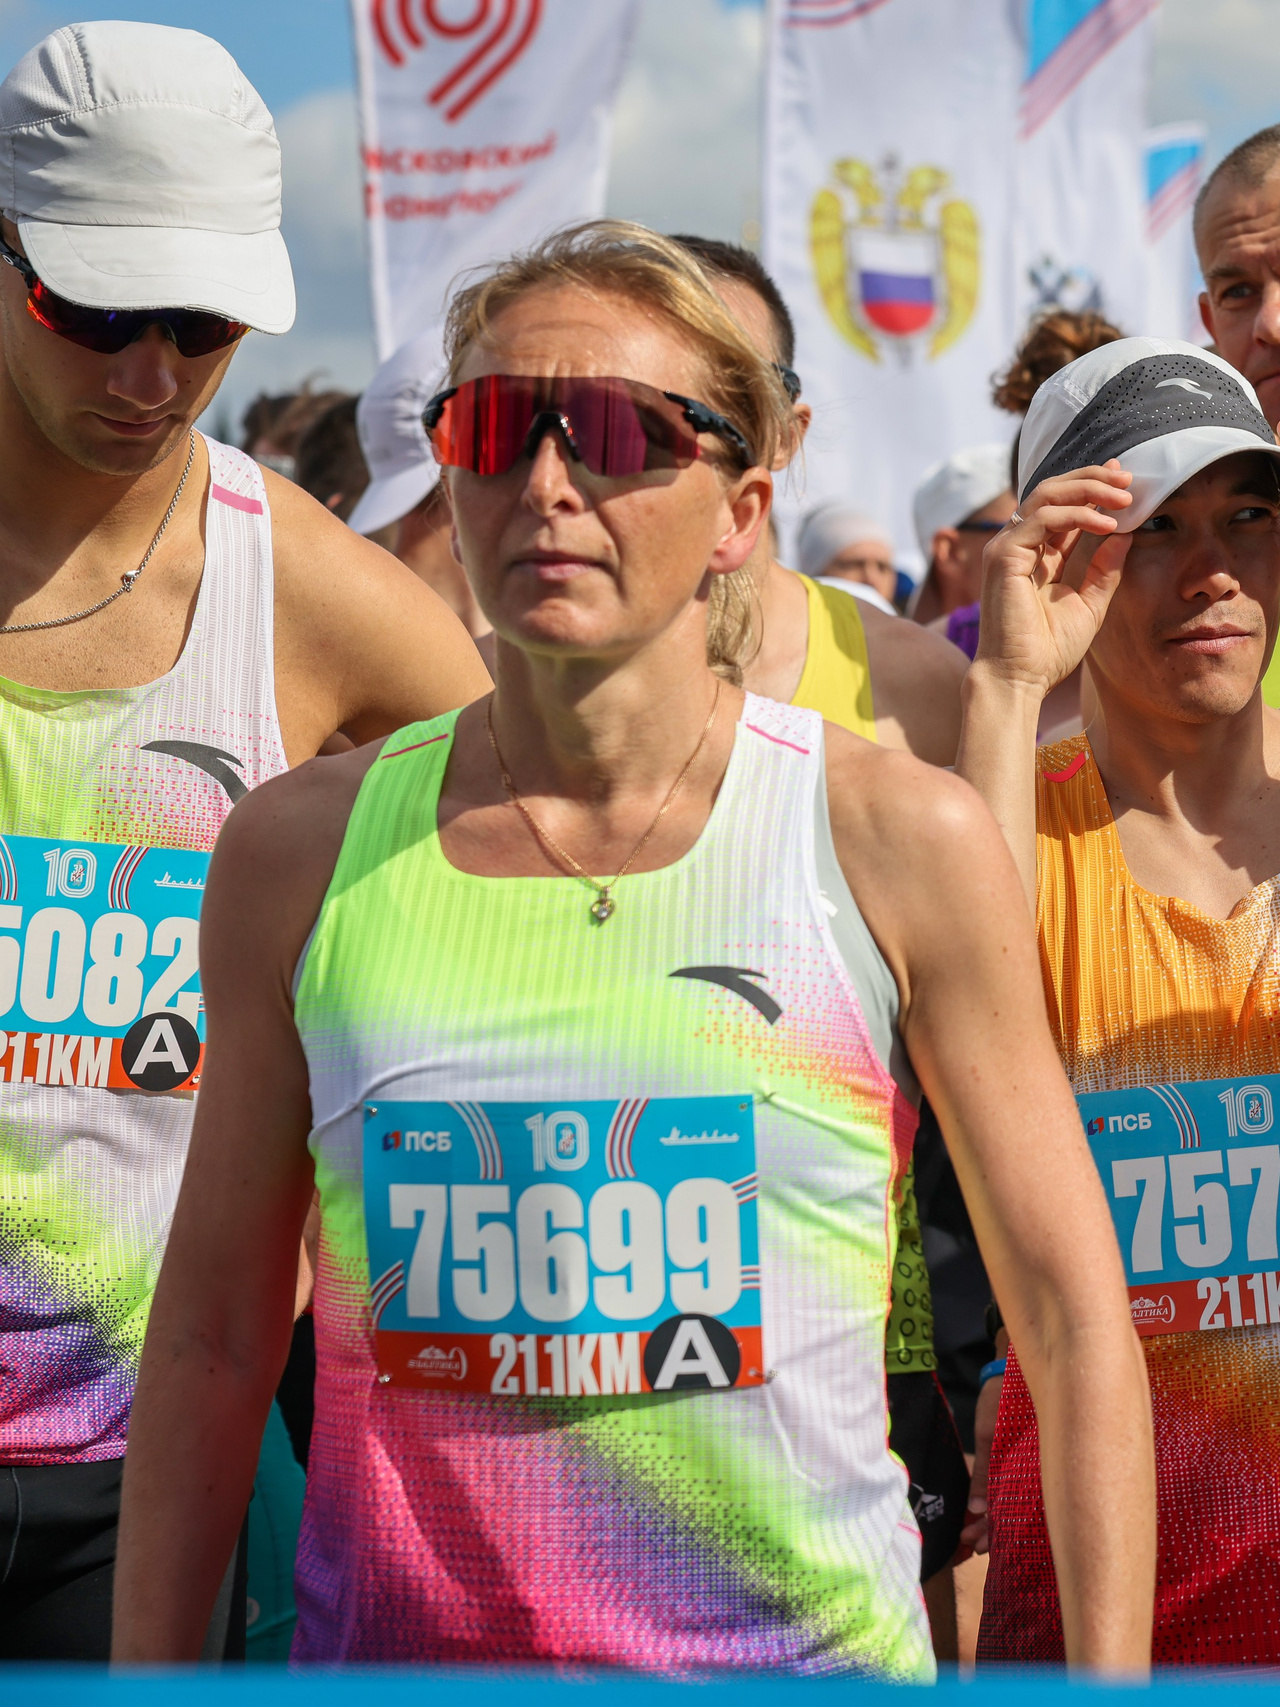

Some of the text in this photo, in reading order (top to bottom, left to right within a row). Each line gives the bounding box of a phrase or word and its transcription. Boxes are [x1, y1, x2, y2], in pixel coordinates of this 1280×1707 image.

[43, 848, 97, 899] 10
[153, 871, 206, 890] Москв
[129, 1018, 189, 1075] A
[1108, 1112, 1152, 1133] ПСБ
[1217, 1084, 1274, 1137] 10
[405, 1130, 452, 1152] ПСБ
[524, 1110, 590, 1172] 10
[388, 1176, 742, 1322] 75699
[1130, 1307, 1169, 1318] АЛТИКА
[653, 1319, 732, 1390] A
